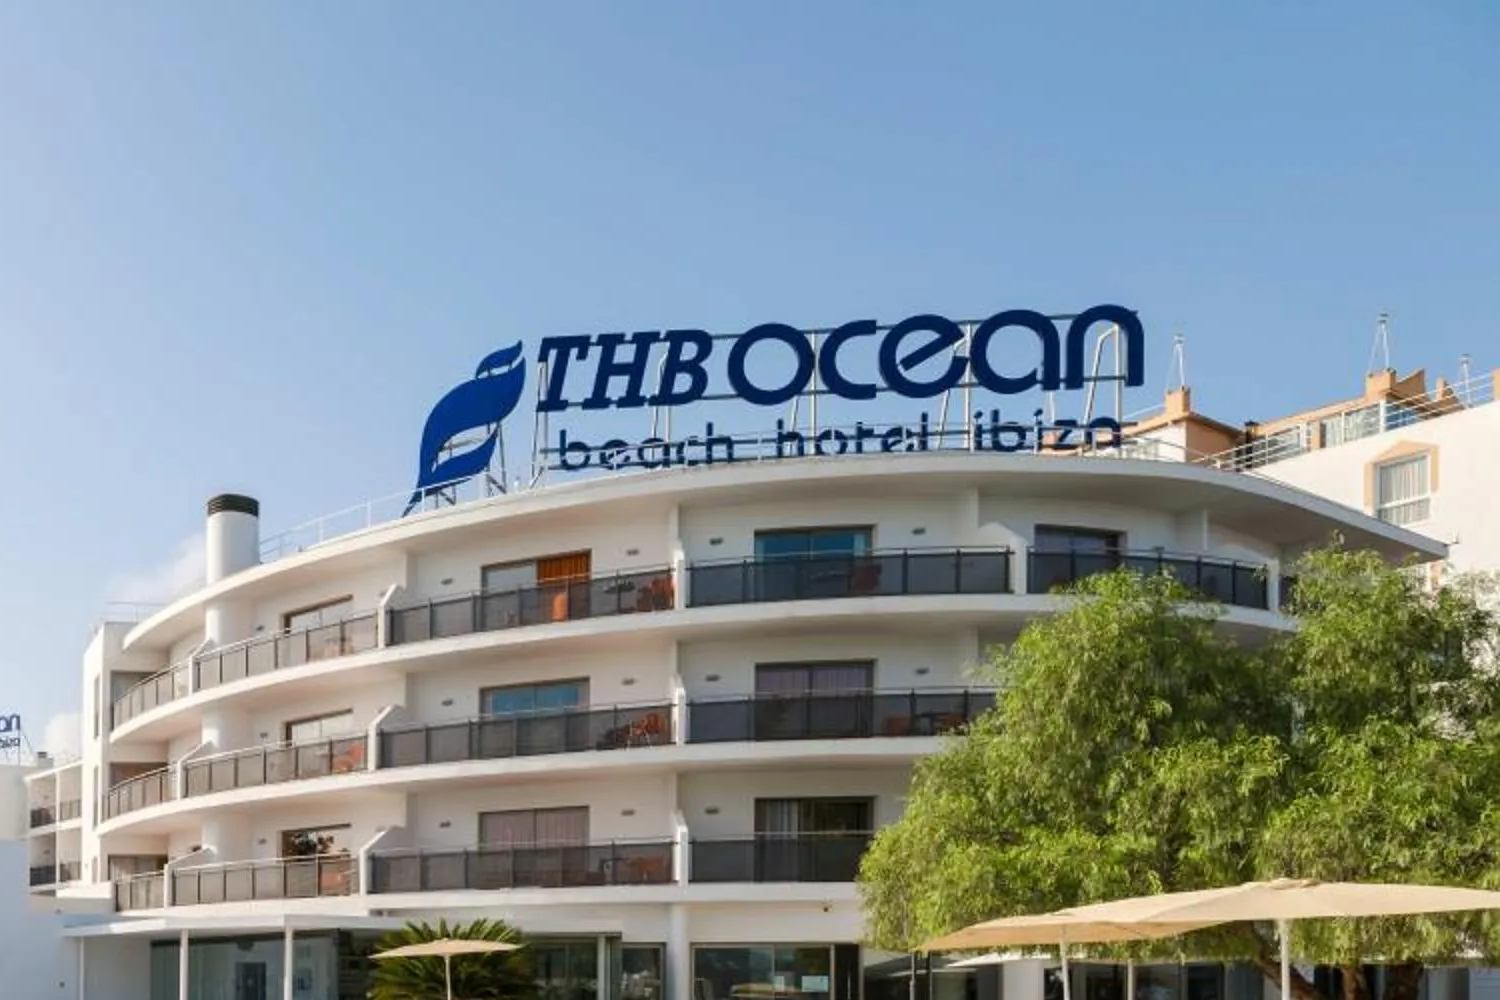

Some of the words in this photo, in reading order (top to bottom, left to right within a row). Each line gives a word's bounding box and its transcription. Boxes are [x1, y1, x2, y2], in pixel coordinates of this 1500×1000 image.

[537, 330, 713, 412] THB
[559, 422, 734, 471] beach
[777, 412, 928, 456] hotel
[974, 409, 1122, 452] ibiza
